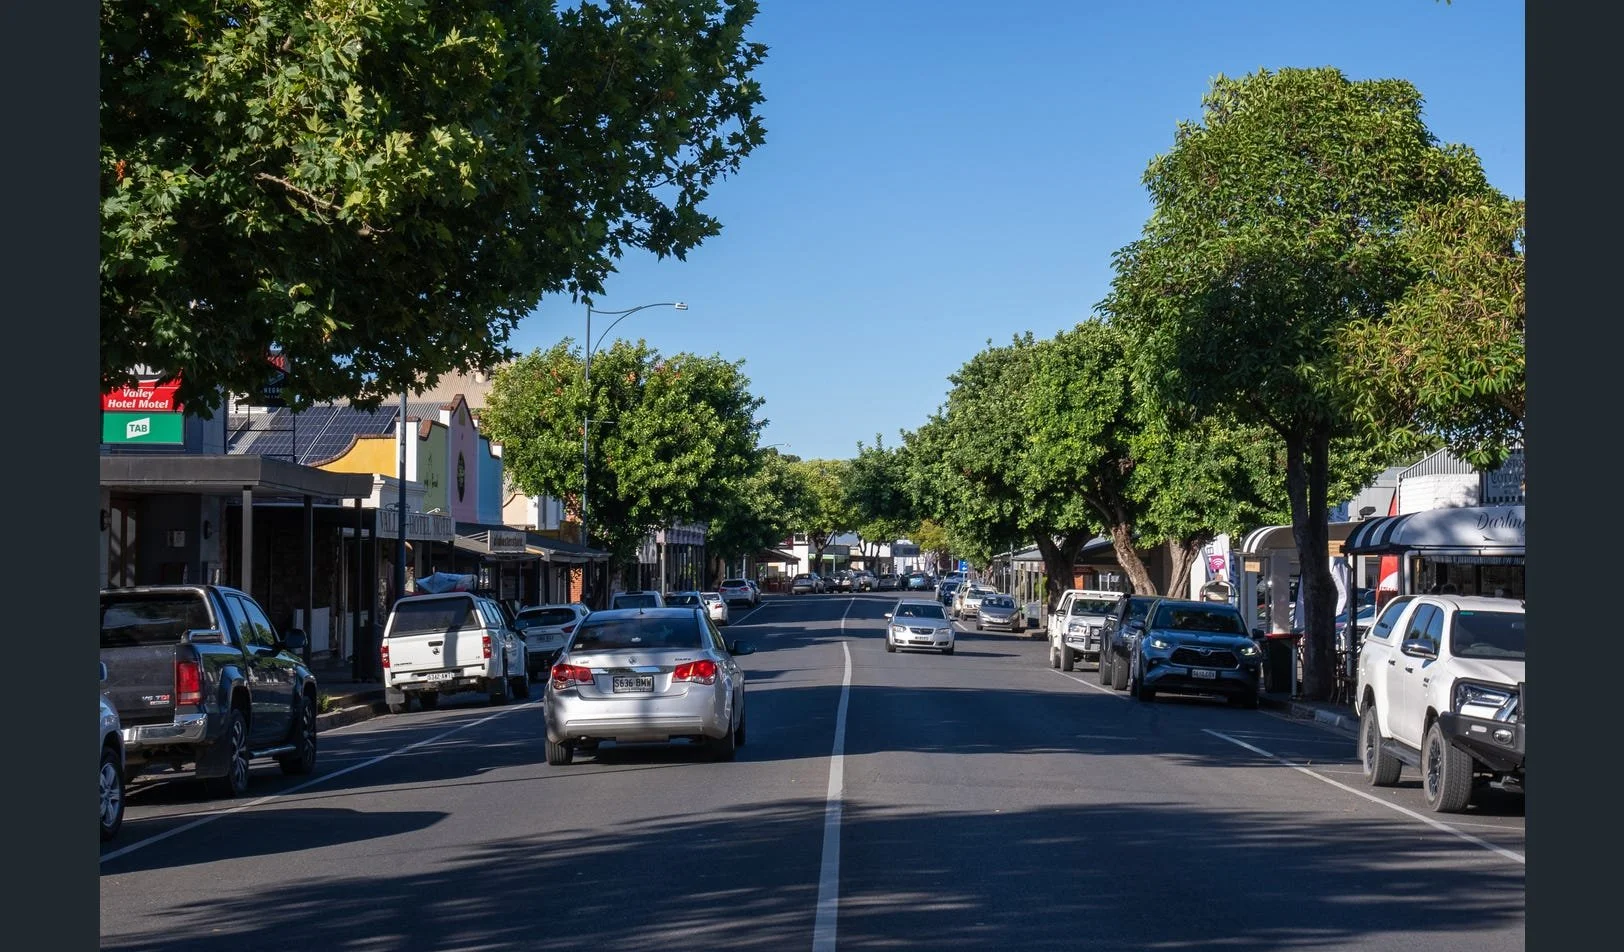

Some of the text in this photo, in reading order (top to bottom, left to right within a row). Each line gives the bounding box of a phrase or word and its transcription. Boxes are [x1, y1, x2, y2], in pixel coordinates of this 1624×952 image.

[123, 388, 154, 400] Valley
[108, 400, 169, 409] Hotel Motel
[129, 424, 148, 433] TAB
[614, 677, 633, 688] S636
